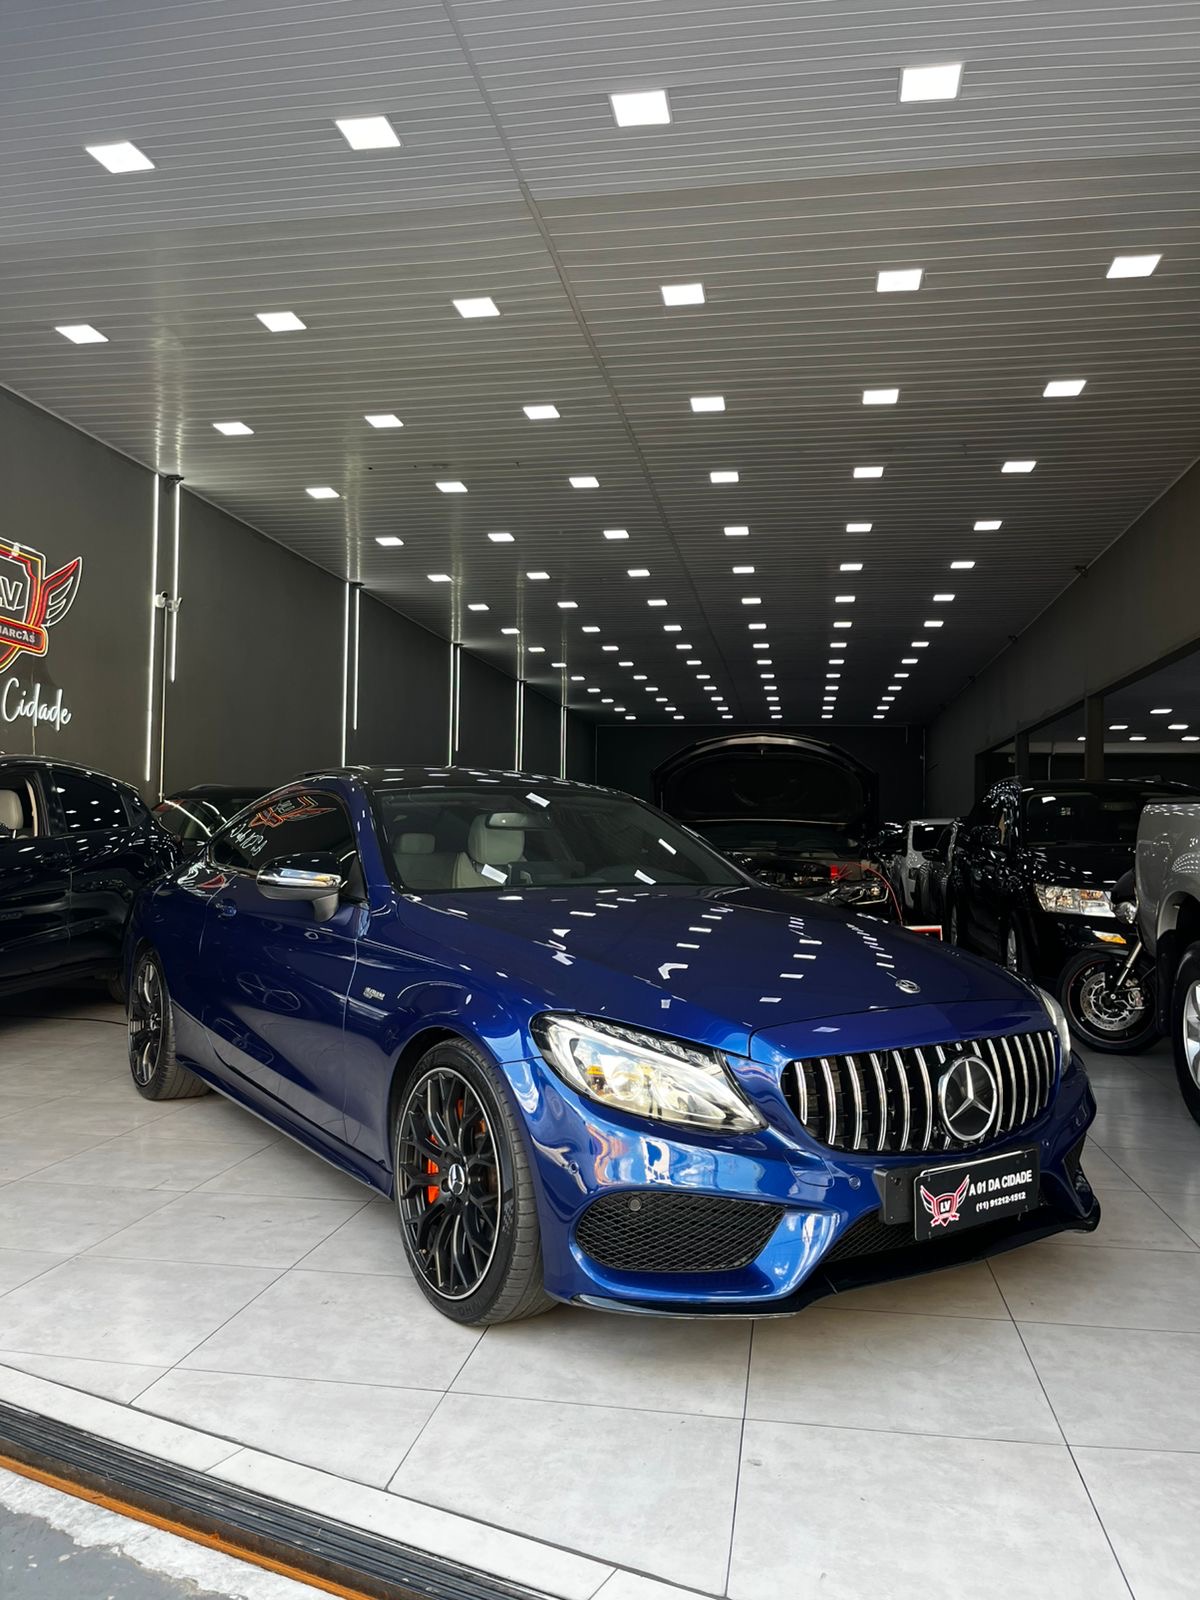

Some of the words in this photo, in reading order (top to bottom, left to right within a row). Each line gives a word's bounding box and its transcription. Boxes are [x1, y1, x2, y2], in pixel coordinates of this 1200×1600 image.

[3, 677, 71, 731] Cidade
[969, 1183, 976, 1196] A
[977, 1181, 987, 1194] 01
[988, 1177, 1000, 1191] DA
[1002, 1169, 1032, 1188] CIDADE
[940, 1200, 951, 1213] LV
[976, 1201, 989, 1212] (11)
